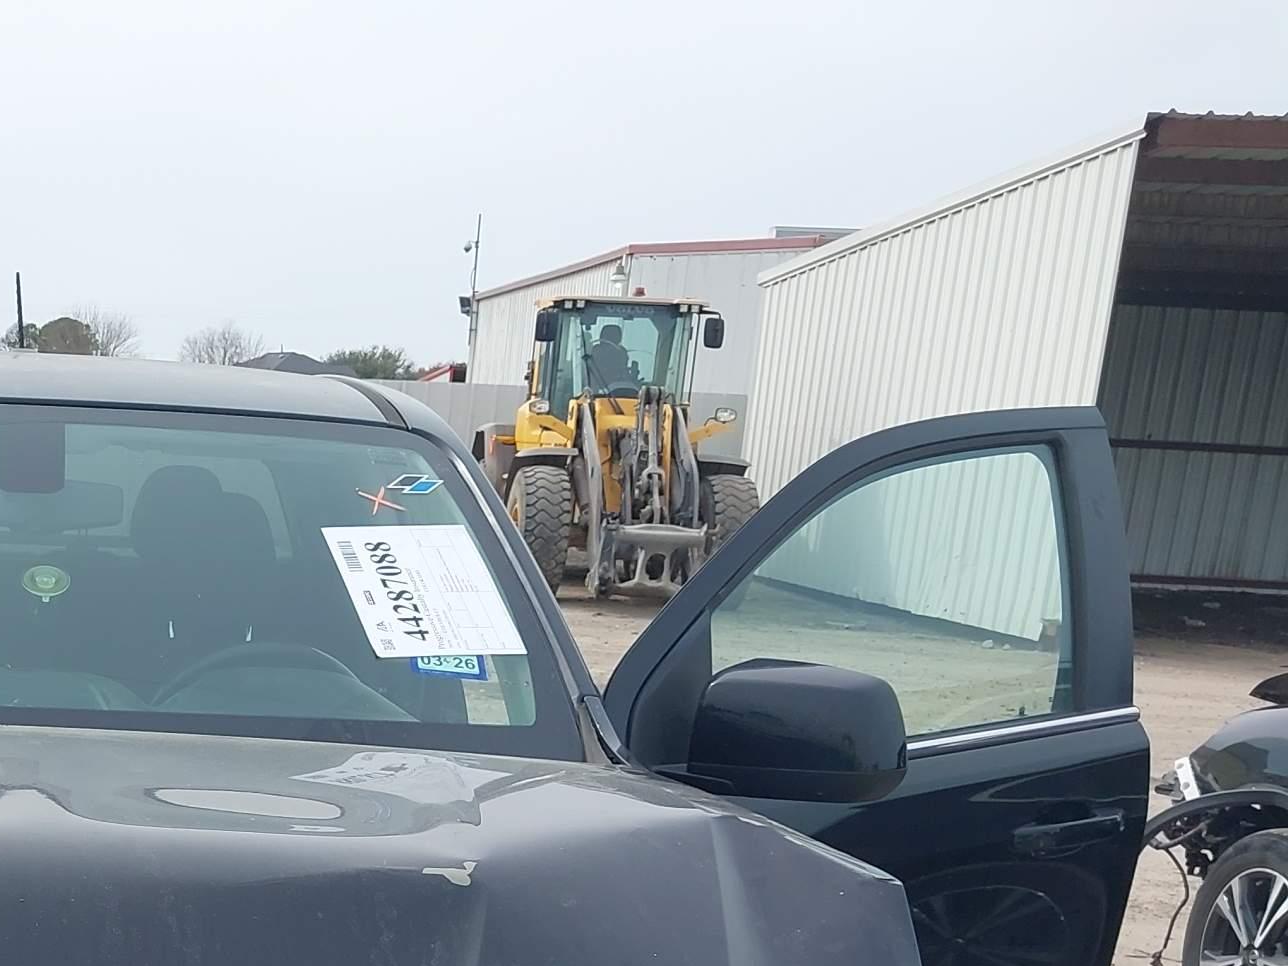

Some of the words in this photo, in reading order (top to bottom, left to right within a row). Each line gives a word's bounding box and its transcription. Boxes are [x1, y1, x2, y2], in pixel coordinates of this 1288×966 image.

[606, 305, 655, 314] VOLVO
[364, 541, 429, 642] 44287088
[453, 657, 476, 670] 26
